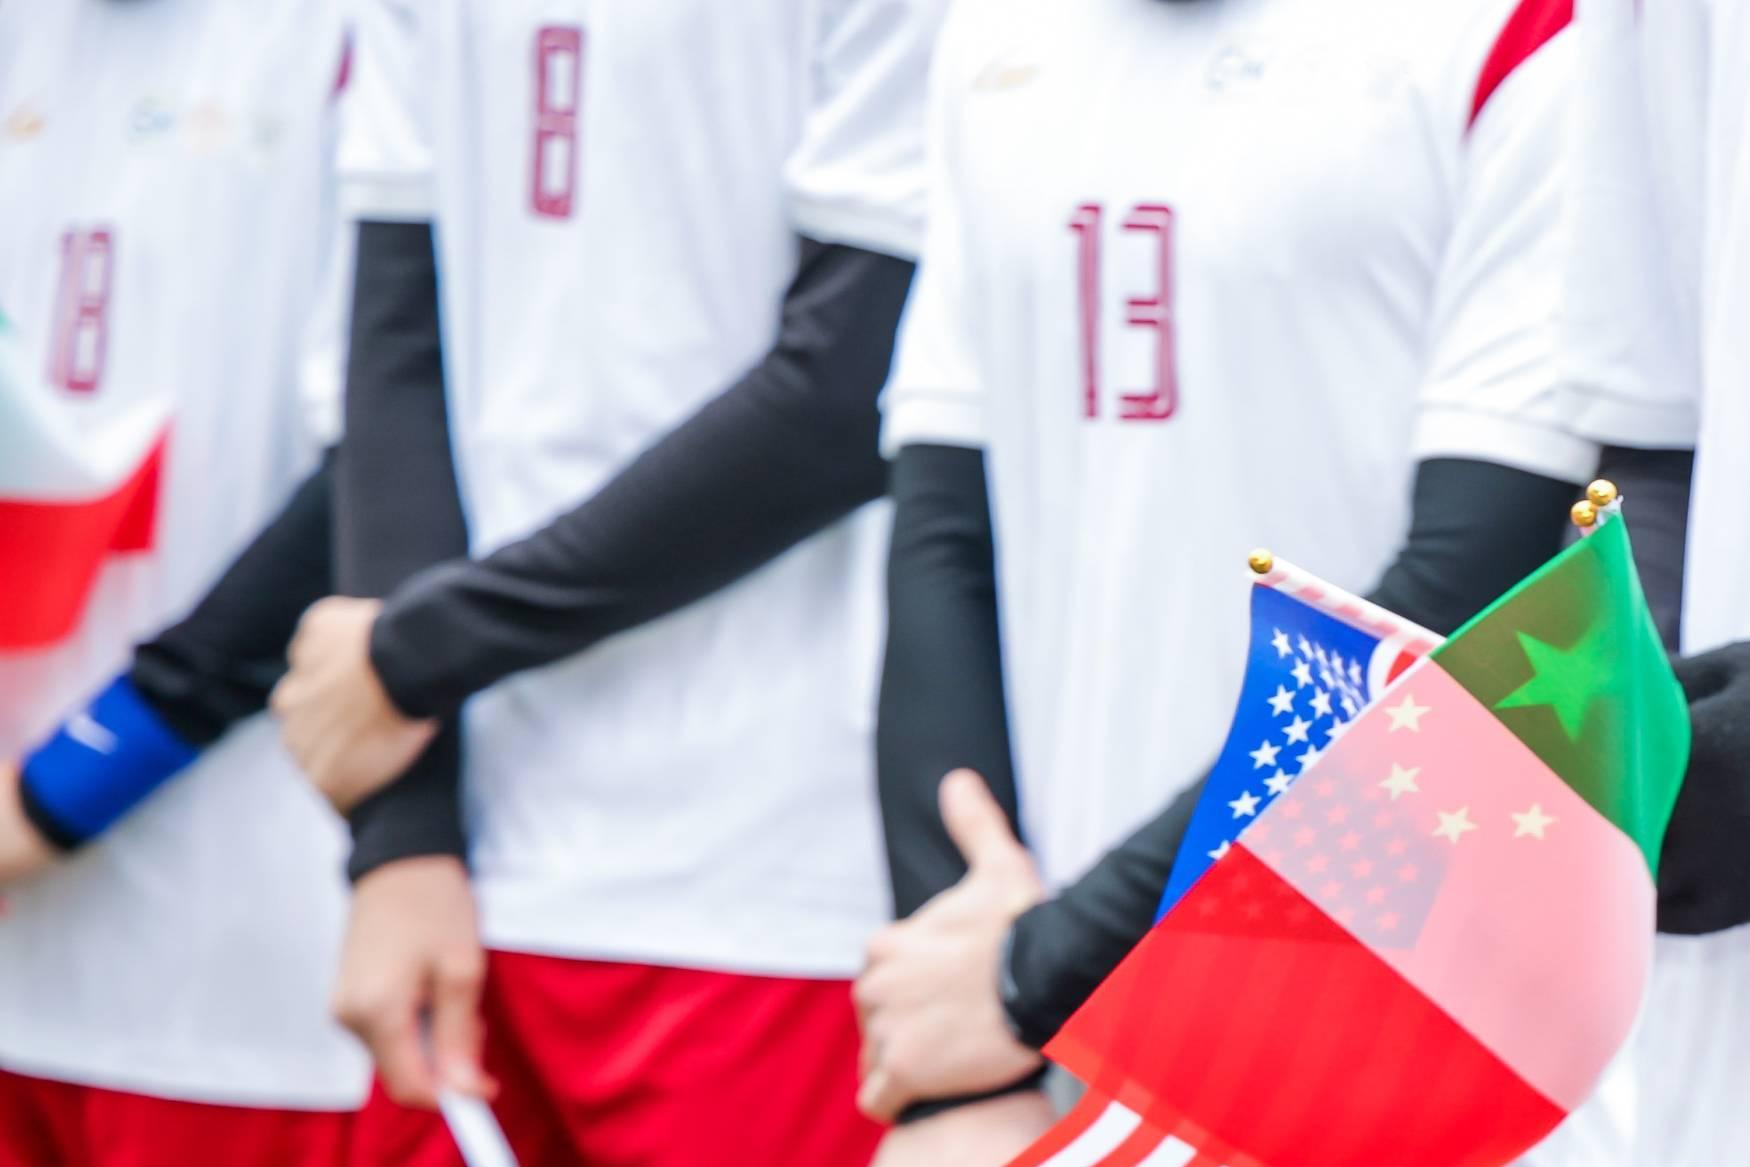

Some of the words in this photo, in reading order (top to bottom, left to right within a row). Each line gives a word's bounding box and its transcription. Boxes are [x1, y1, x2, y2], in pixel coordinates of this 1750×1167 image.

[528, 25, 584, 222] 8
[45, 226, 115, 400] 18
[1066, 200, 1180, 425] 13
